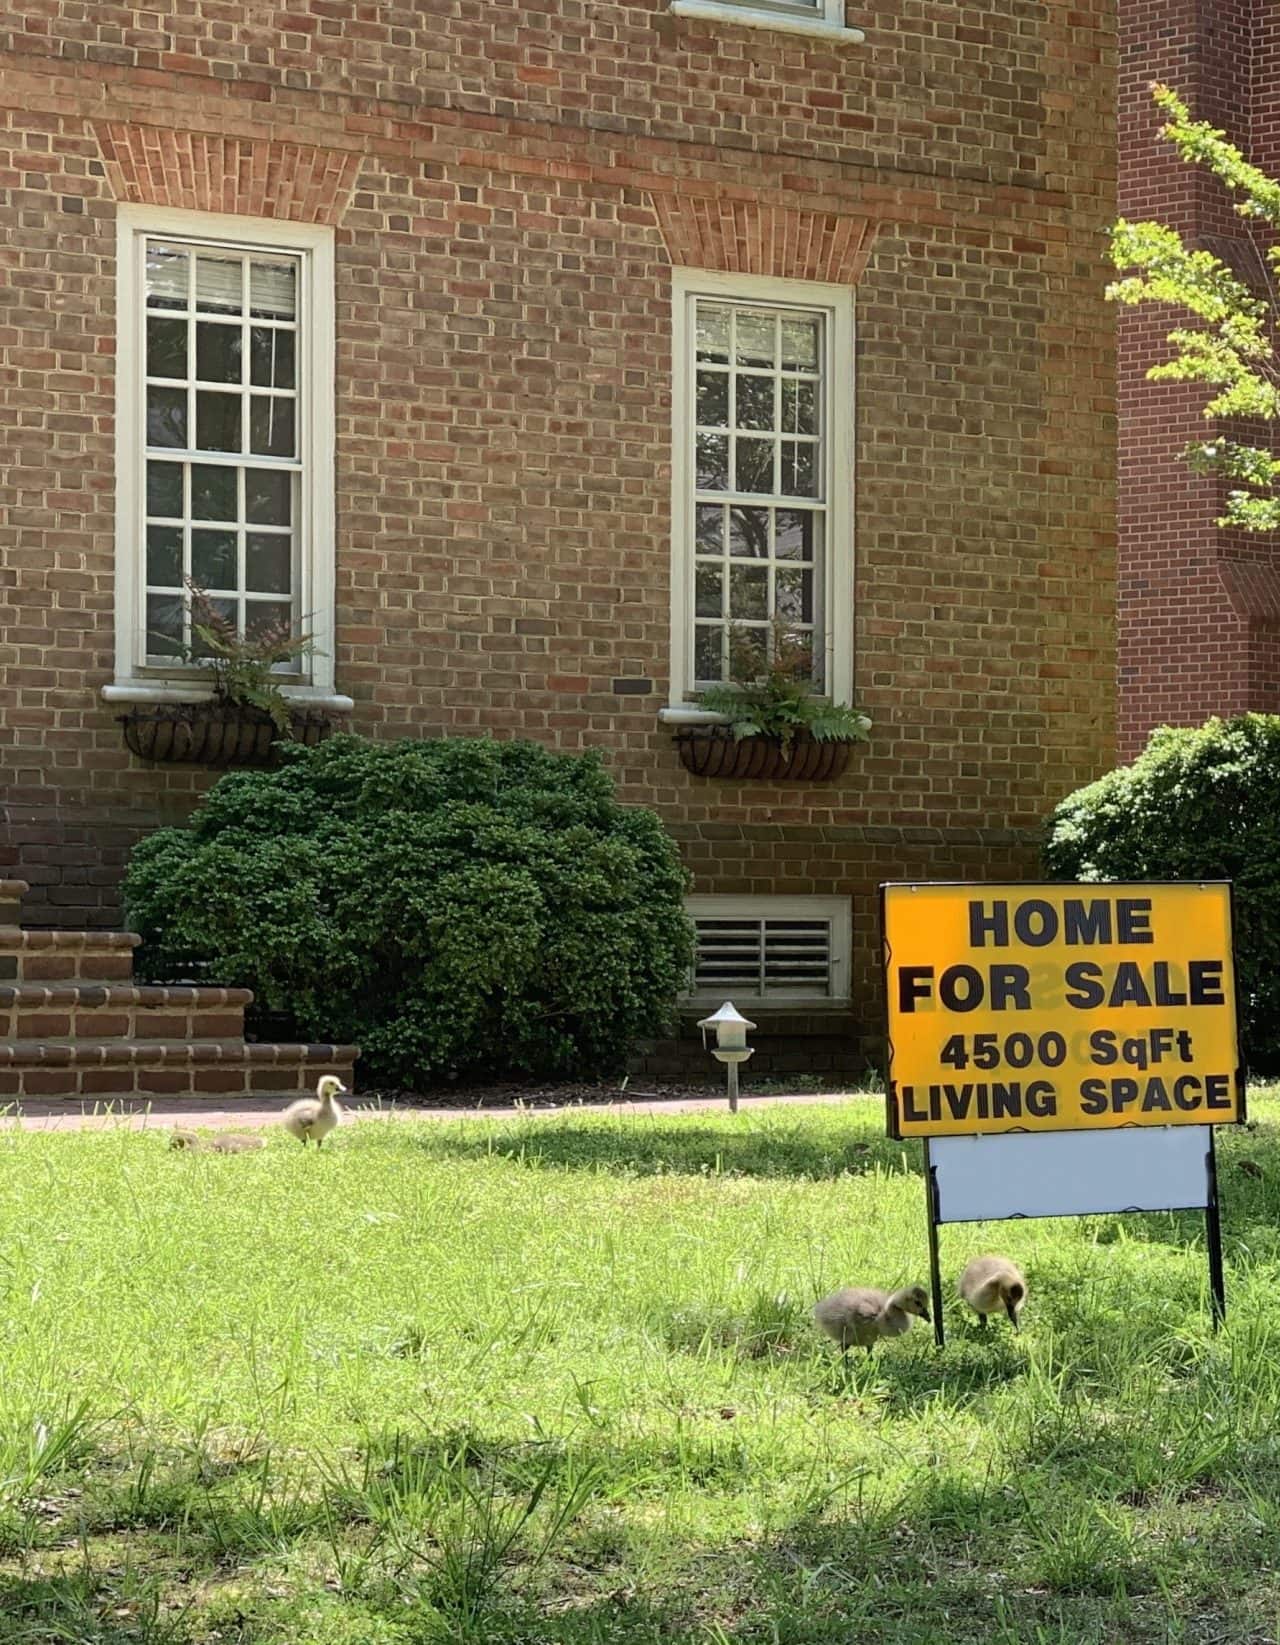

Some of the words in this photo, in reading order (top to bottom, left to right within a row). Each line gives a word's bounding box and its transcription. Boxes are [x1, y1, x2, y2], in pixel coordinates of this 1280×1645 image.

[968, 898, 1154, 947] HOME
[898, 964, 1032, 1013] FOR
[1064, 960, 1225, 1009] SALE
[940, 1030, 1067, 1070] 4500
[1090, 1028, 1193, 1070] SqFt
[902, 1080, 1057, 1122] LIVING
[1079, 1075, 1232, 1115] SPACE
